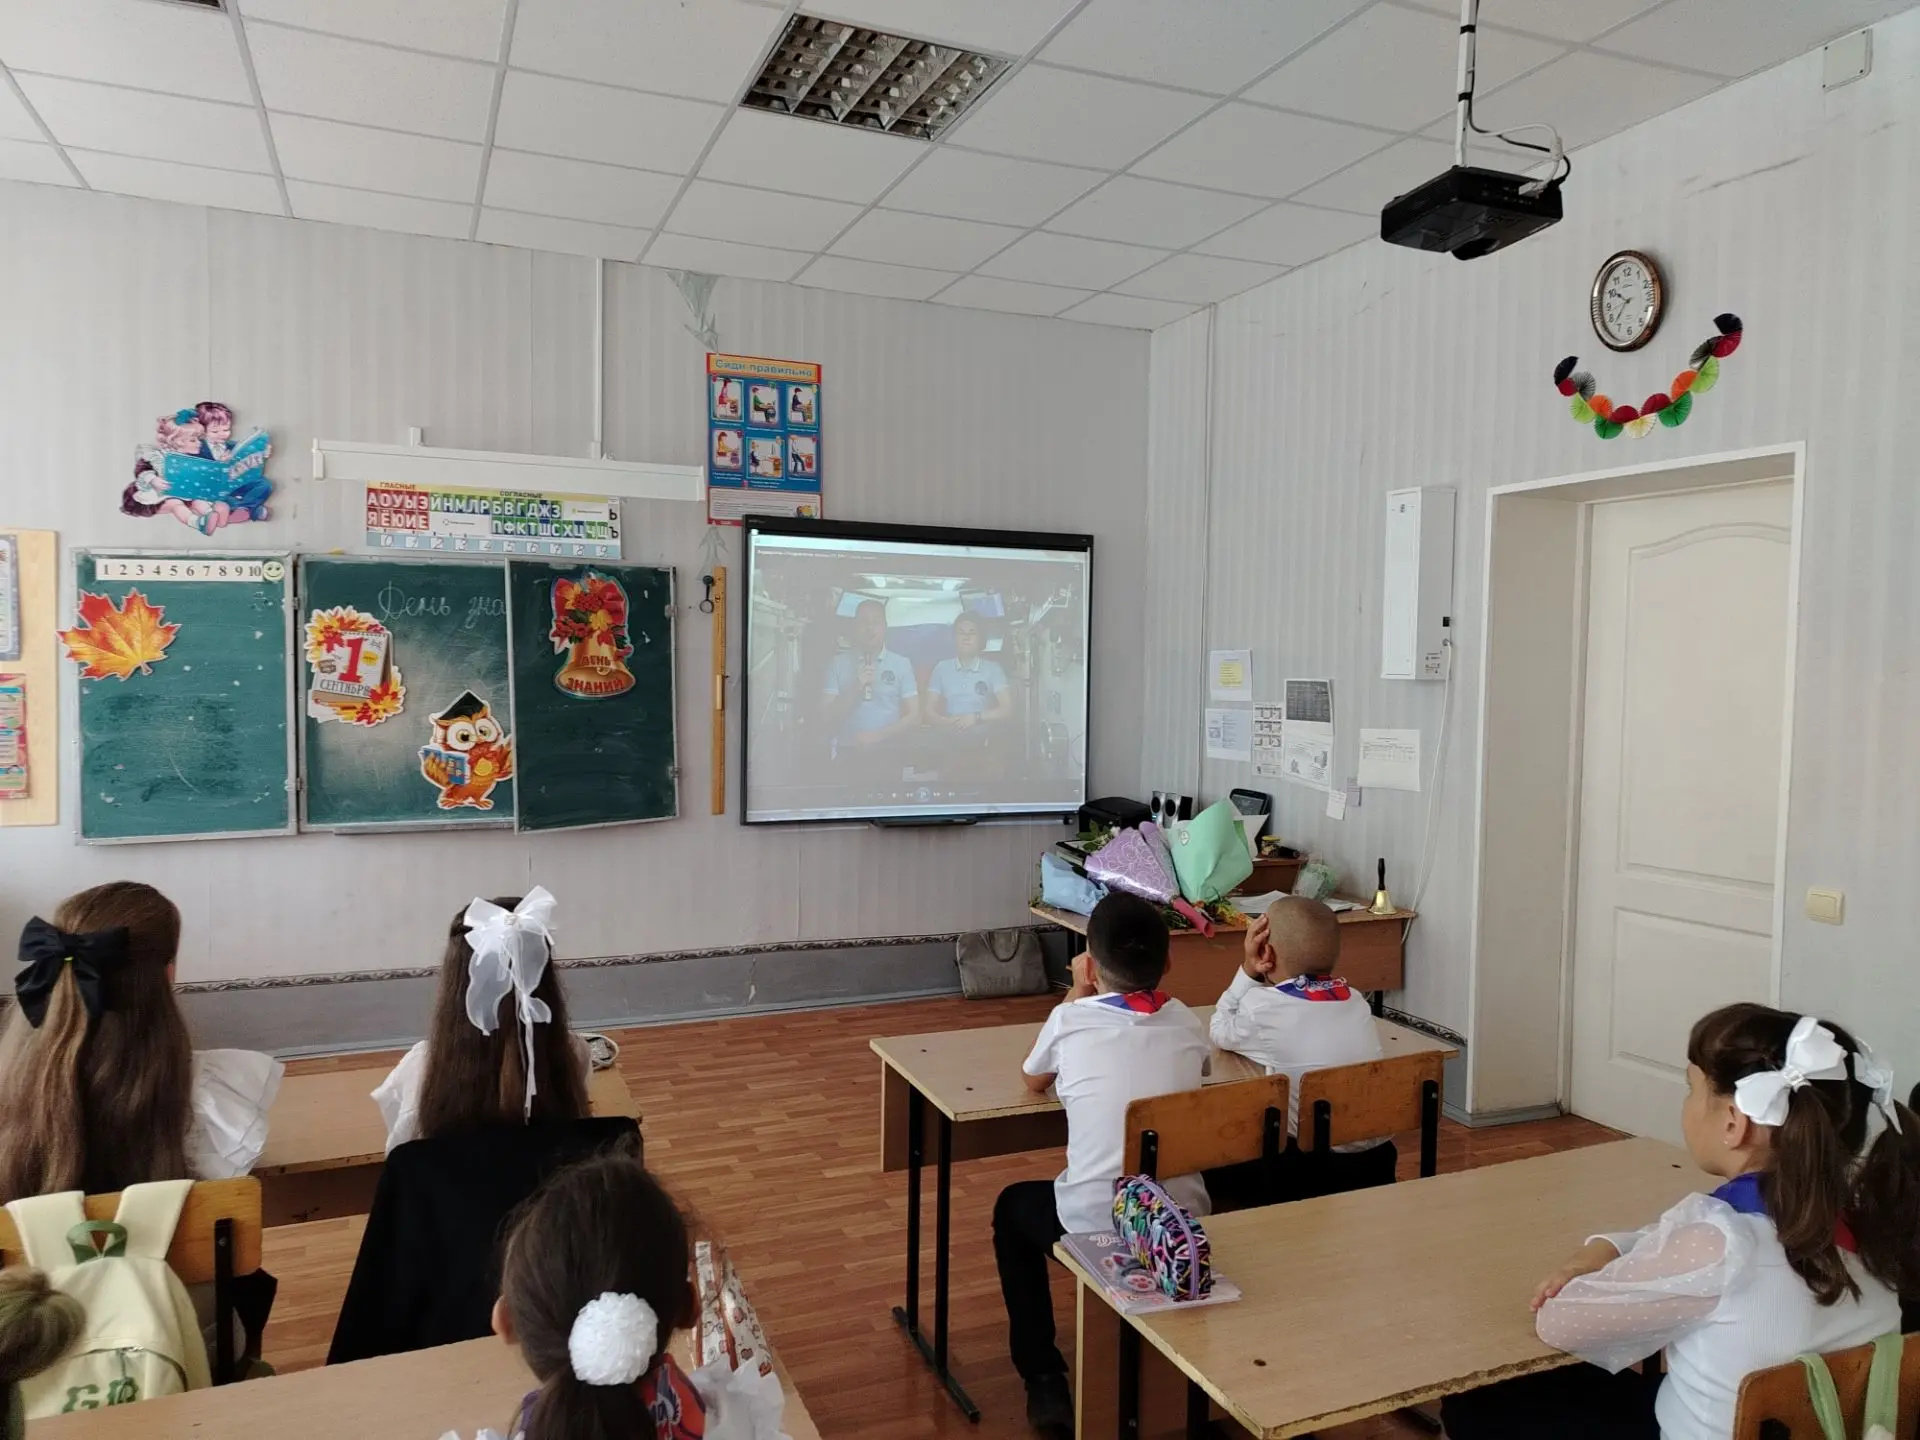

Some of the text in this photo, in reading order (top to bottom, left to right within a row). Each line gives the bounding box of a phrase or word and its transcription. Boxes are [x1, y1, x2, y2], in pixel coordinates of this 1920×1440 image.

[1623, 267, 1632, 277] 12
[1613, 276, 1620, 285] 11
[1608, 288, 1617, 298] 10
[1627, 326, 1632, 335] 6
[716, 359, 813, 378] Сиди правильно
[380, 482, 416, 490] ГЛАСНЫЕ
[500, 490, 542, 498] СОГЛАСНЫЕ
[103, 564, 262, 577] 1 2 3 4 5 6 7 8 9 10
[378, 581, 451, 623] День
[338, 637, 365, 683] 1
[581, 655, 611, 666] ДЕНЬ
[320, 679, 371, 697] СЕНТЯБРЯ
